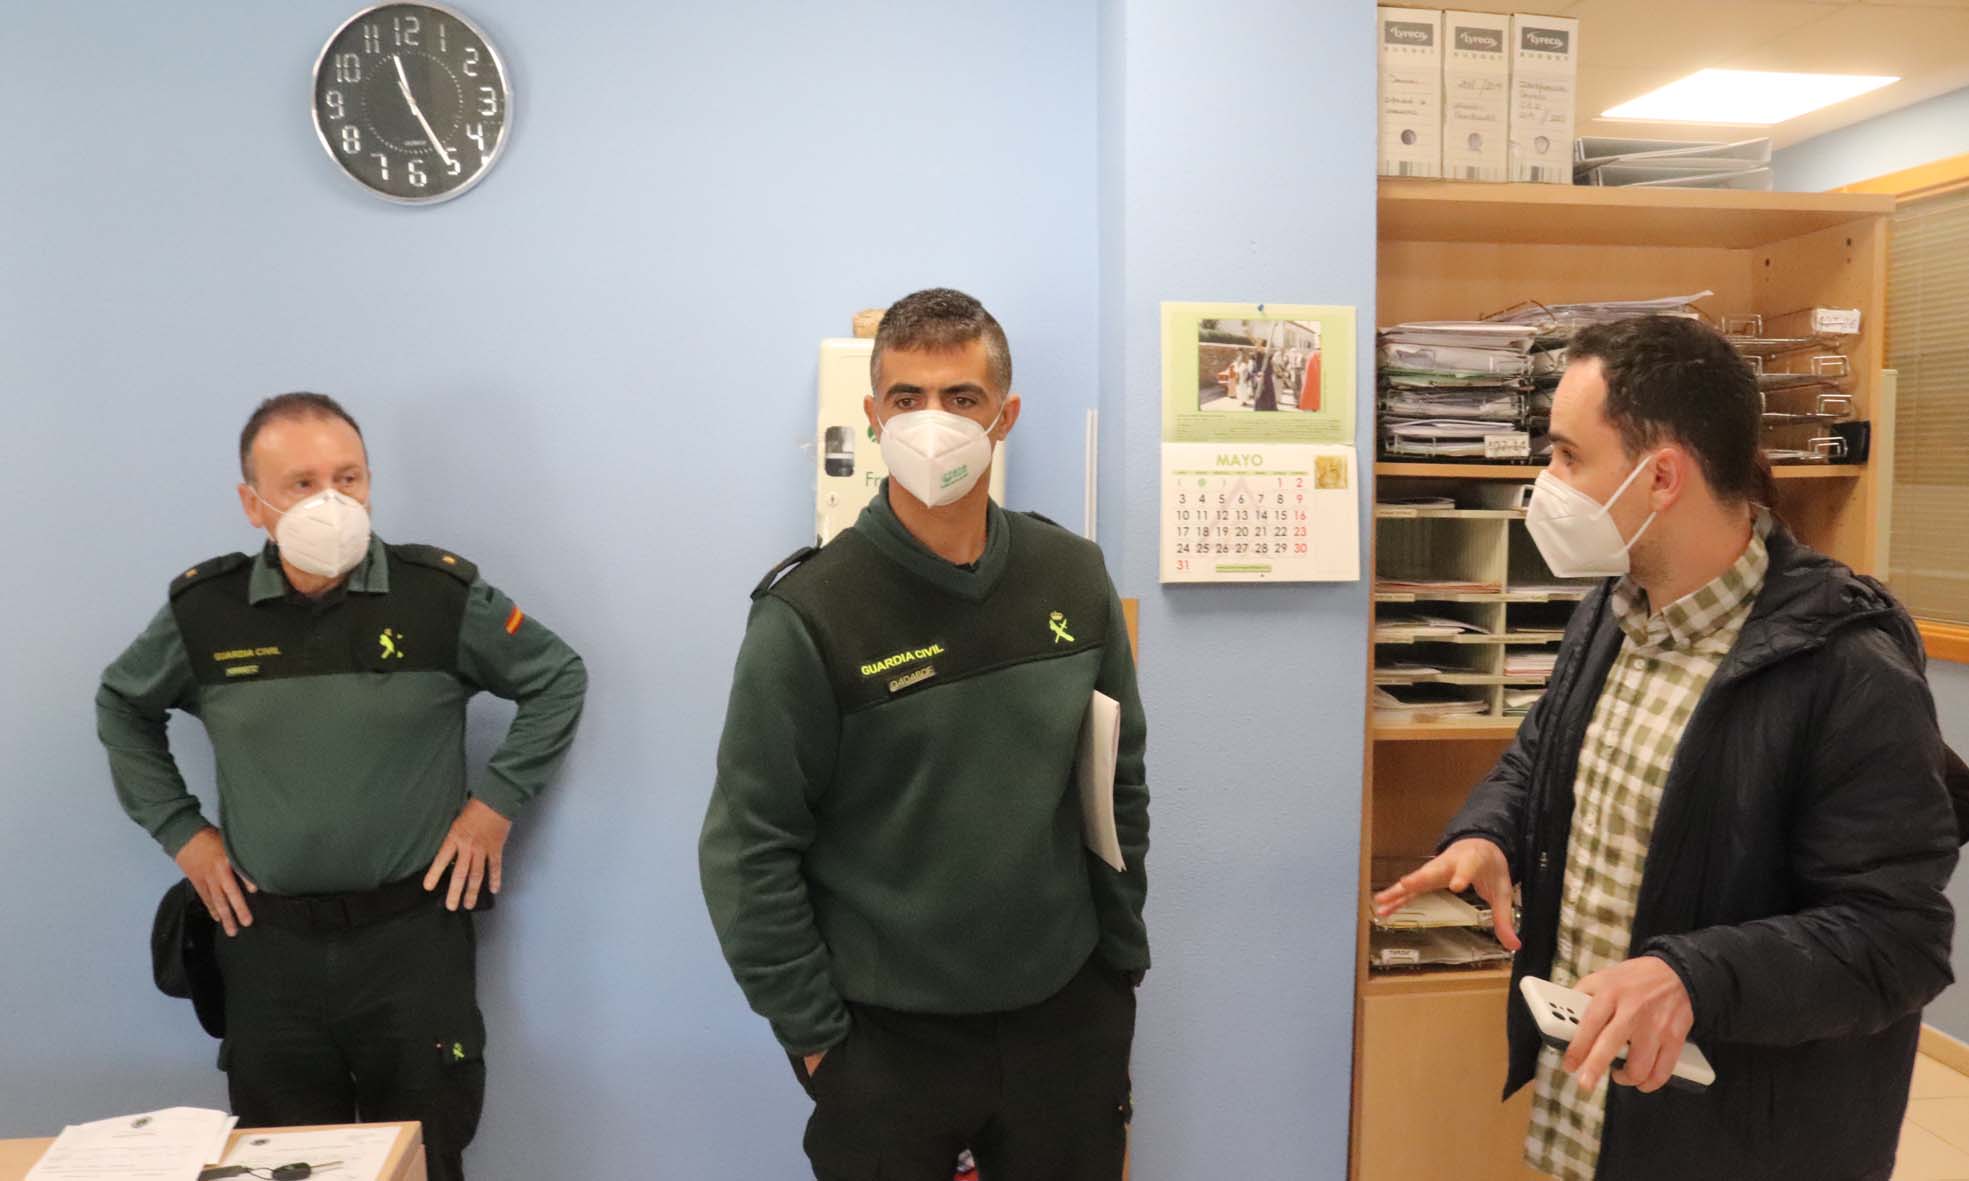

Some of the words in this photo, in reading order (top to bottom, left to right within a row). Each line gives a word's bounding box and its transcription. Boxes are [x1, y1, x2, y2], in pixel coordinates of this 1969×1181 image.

[364, 25, 380, 53] 11
[394, 17, 420, 46] 12
[439, 24, 447, 52] 1
[336, 53, 361, 83] 10
[463, 47, 479, 76] 2
[326, 90, 344, 119] 9
[479, 86, 497, 116] 3
[342, 125, 360, 154] 8
[466, 123, 484, 150] 4
[371, 153, 389, 180] 7
[408, 159, 427, 187] 6
[446, 147, 461, 175] 5
[1216, 454, 1264, 467] MAYO
[1296, 478, 1303, 488] 2
[1178, 494, 1186, 504] 3
[1198, 494, 1206, 504] 4
[1218, 494, 1225, 504] 5
[1238, 494, 1245, 504] 6
[1258, 494, 1264, 504] 7
[1276, 494, 1284, 504] 8
[1177, 510, 1190, 520] 10
[1197, 510, 1208, 520] 11
[1216, 510, 1229, 520] 12
[1236, 510, 1248, 520] 13
[1255, 510, 1268, 520] 14
[1275, 510, 1287, 520] 15
[1294, 510, 1306, 520] 16
[1177, 526, 1190, 537] 17
[1197, 526, 1210, 537] 18
[1216, 526, 1228, 537] 19
[1236, 526, 1249, 537] 20
[1255, 526, 1267, 537] 21
[1274, 526, 1287, 537] 22
[1294, 526, 1307, 537] 23
[1177, 543, 1190, 554] 24
[1196, 543, 1210, 554] 25
[1216, 543, 1229, 554] 26
[1235, 543, 1249, 554] 27
[1255, 543, 1268, 554] 28
[1275, 543, 1288, 554] 29
[1294, 543, 1308, 554] 30
[1176, 560, 1190, 570] 31
[860, 651, 915, 676] GUARDIA
[914, 643, 945, 659] CIVIL
